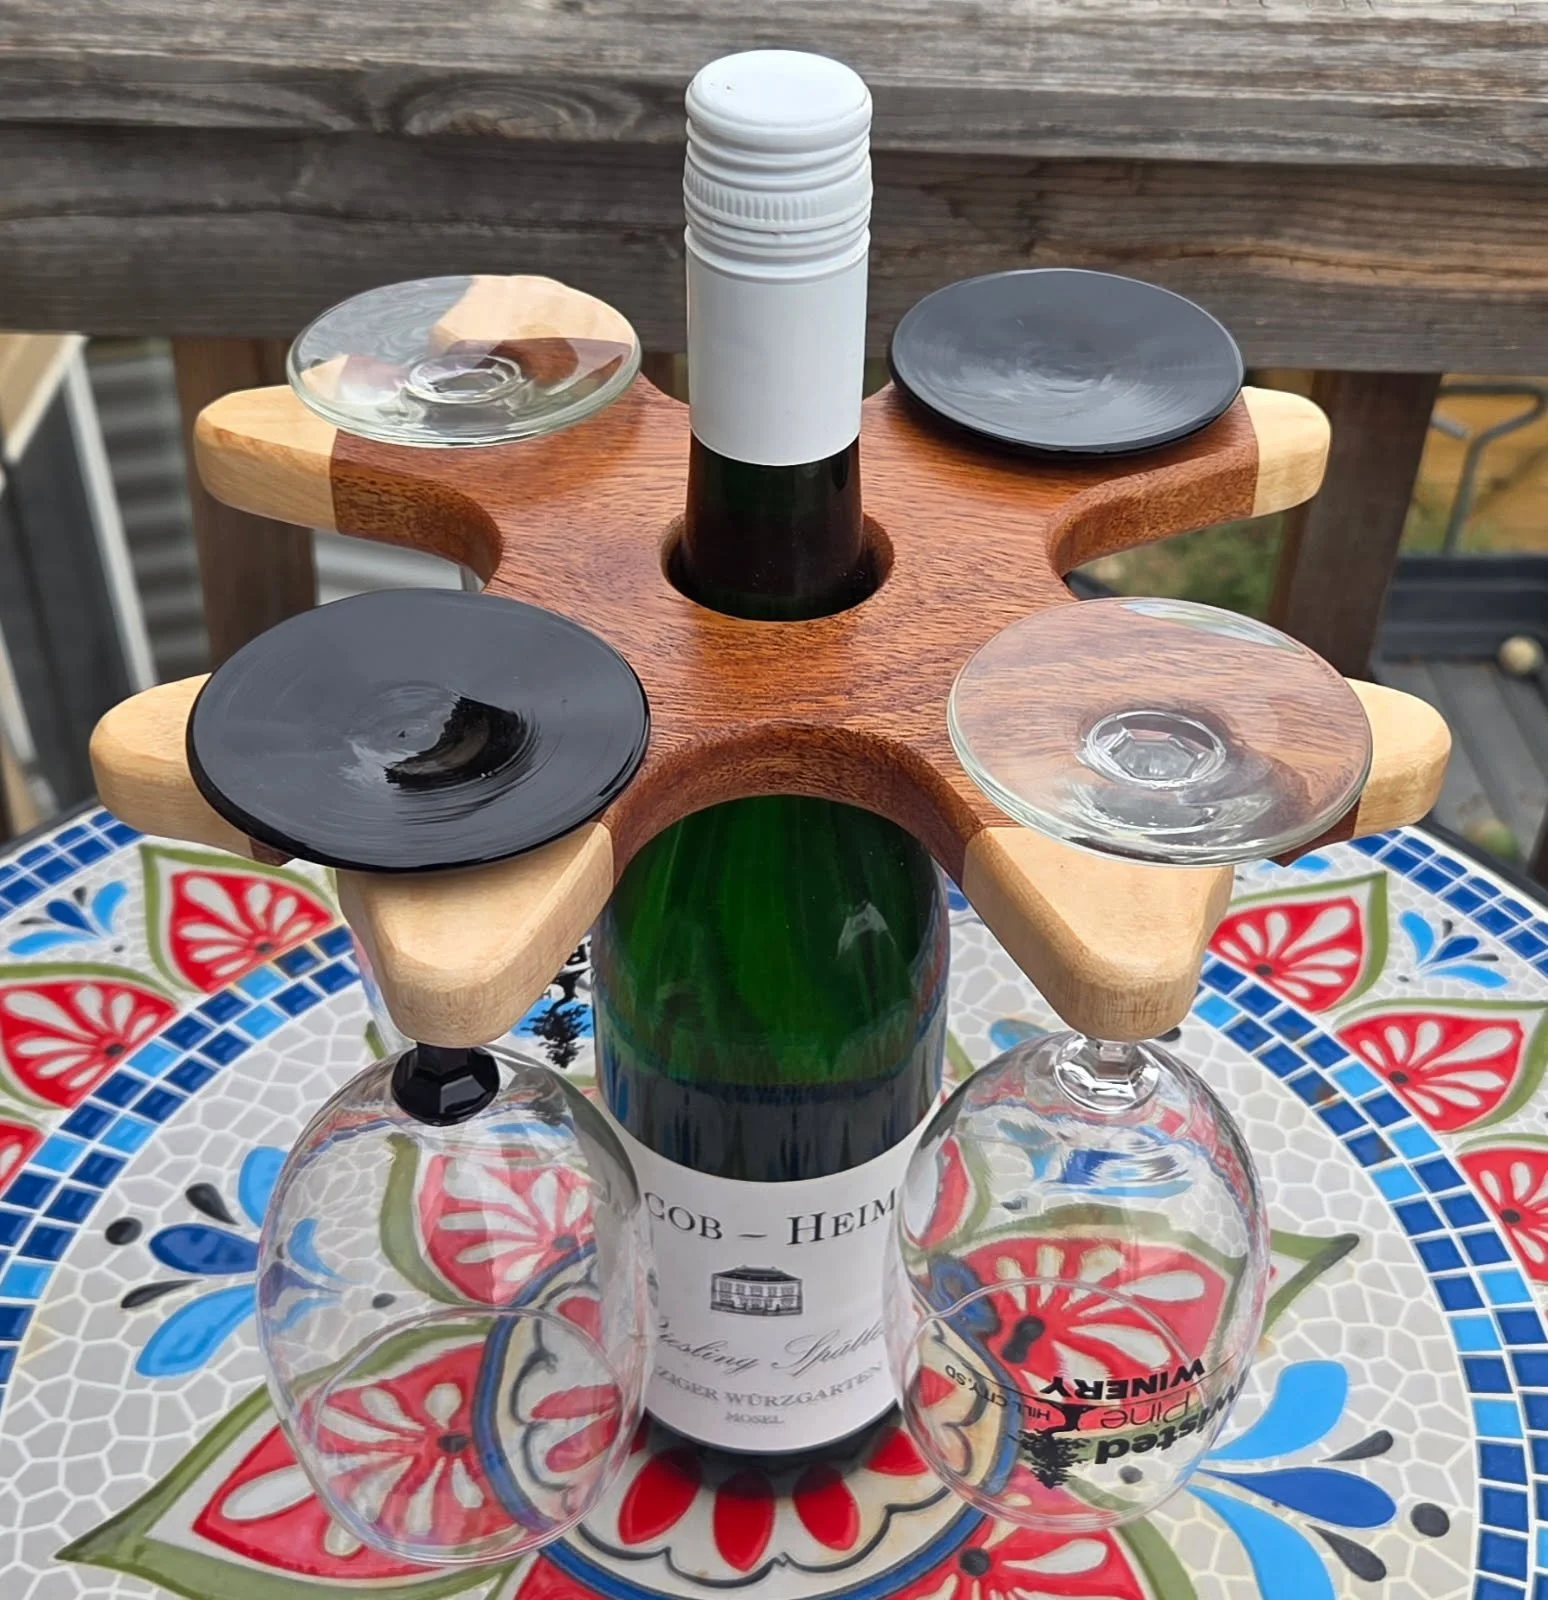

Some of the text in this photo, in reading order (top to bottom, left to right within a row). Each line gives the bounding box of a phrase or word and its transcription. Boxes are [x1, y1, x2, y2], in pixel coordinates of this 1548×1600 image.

[644, 1191, 723, 1240] COB
[658, 1315, 760, 1376] iesling
[656, 1362, 883, 1408] ZIGER WÜRZGARTEN
[1040, 1358, 1206, 1401] WINERY
[725, 1411, 784, 1426] MOSEL
[1013, 1402, 1051, 1422] HILL
[1094, 1370, 1246, 1465] wisted
